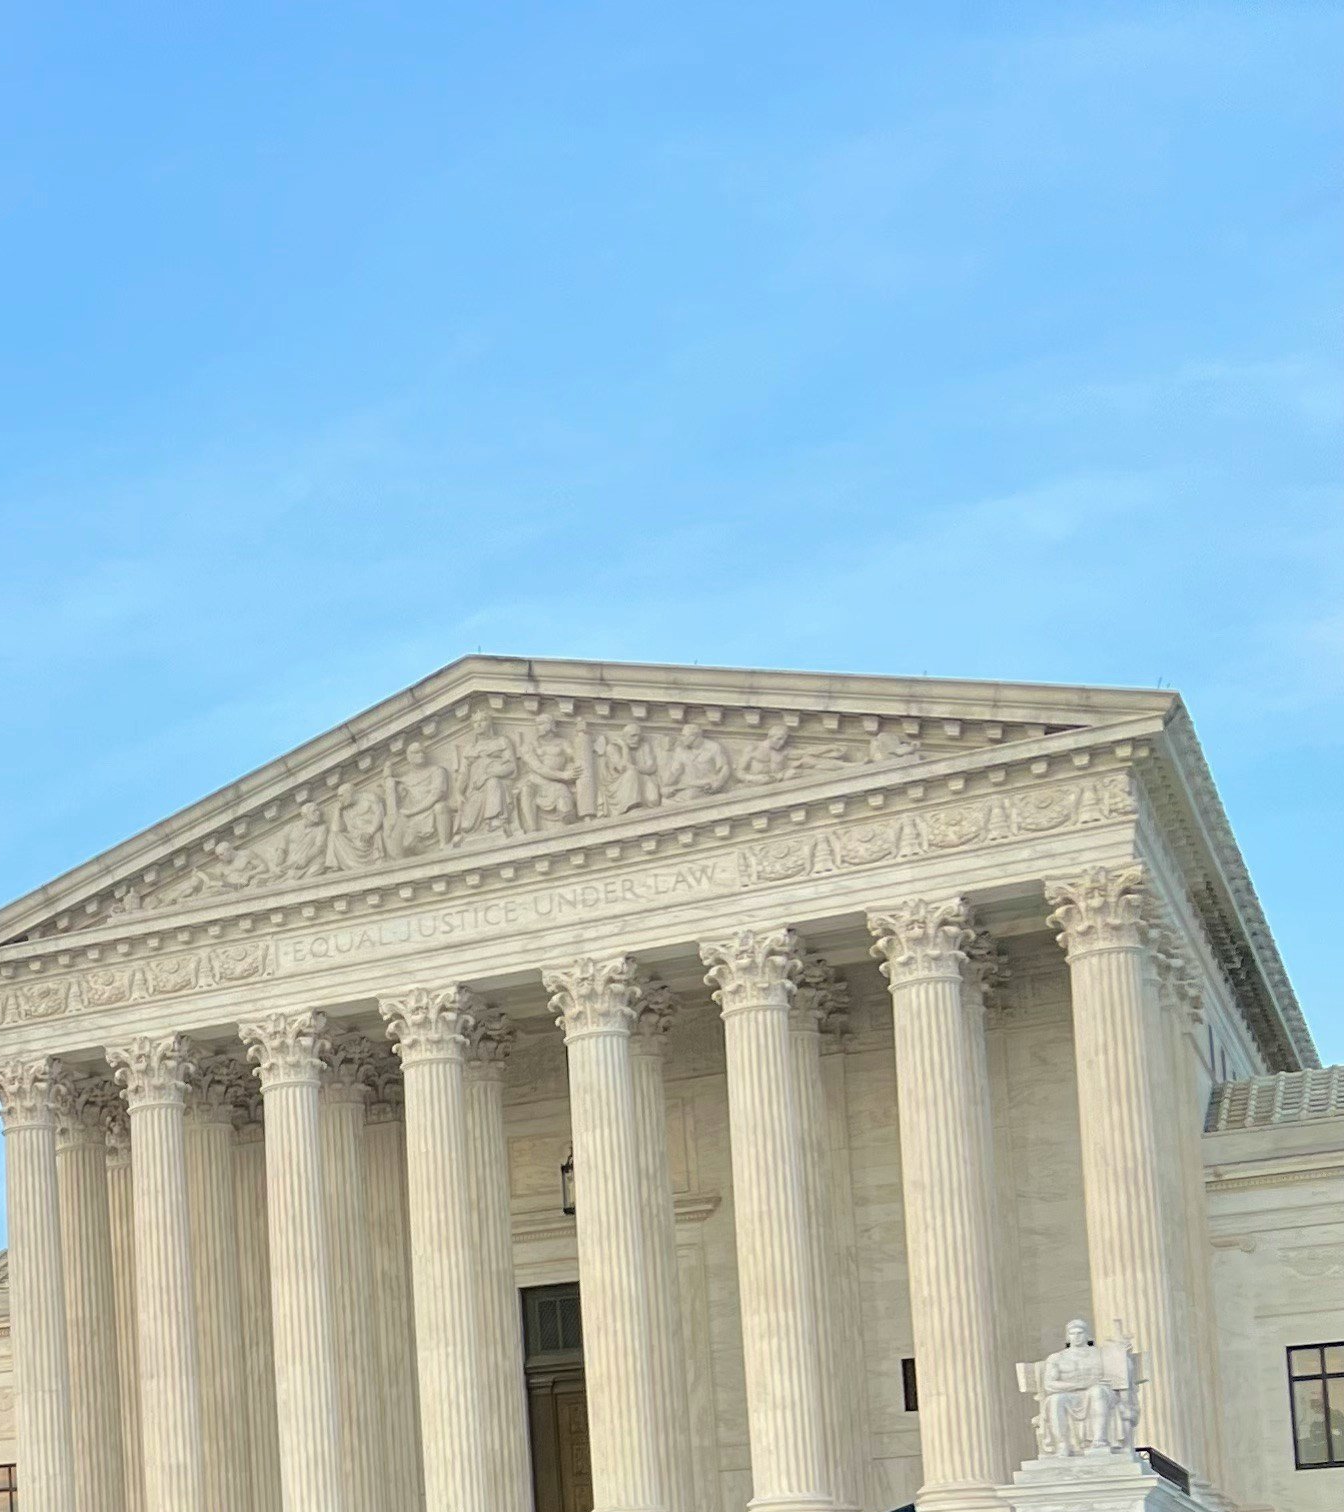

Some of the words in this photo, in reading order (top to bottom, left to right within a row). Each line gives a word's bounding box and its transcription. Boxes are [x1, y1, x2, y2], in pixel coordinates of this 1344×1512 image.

[293, 929, 392, 964] EQUAL
[399, 904, 521, 944] JUSTICE
[534, 877, 643, 917] UNDER
[652, 862, 716, 897] LAW
